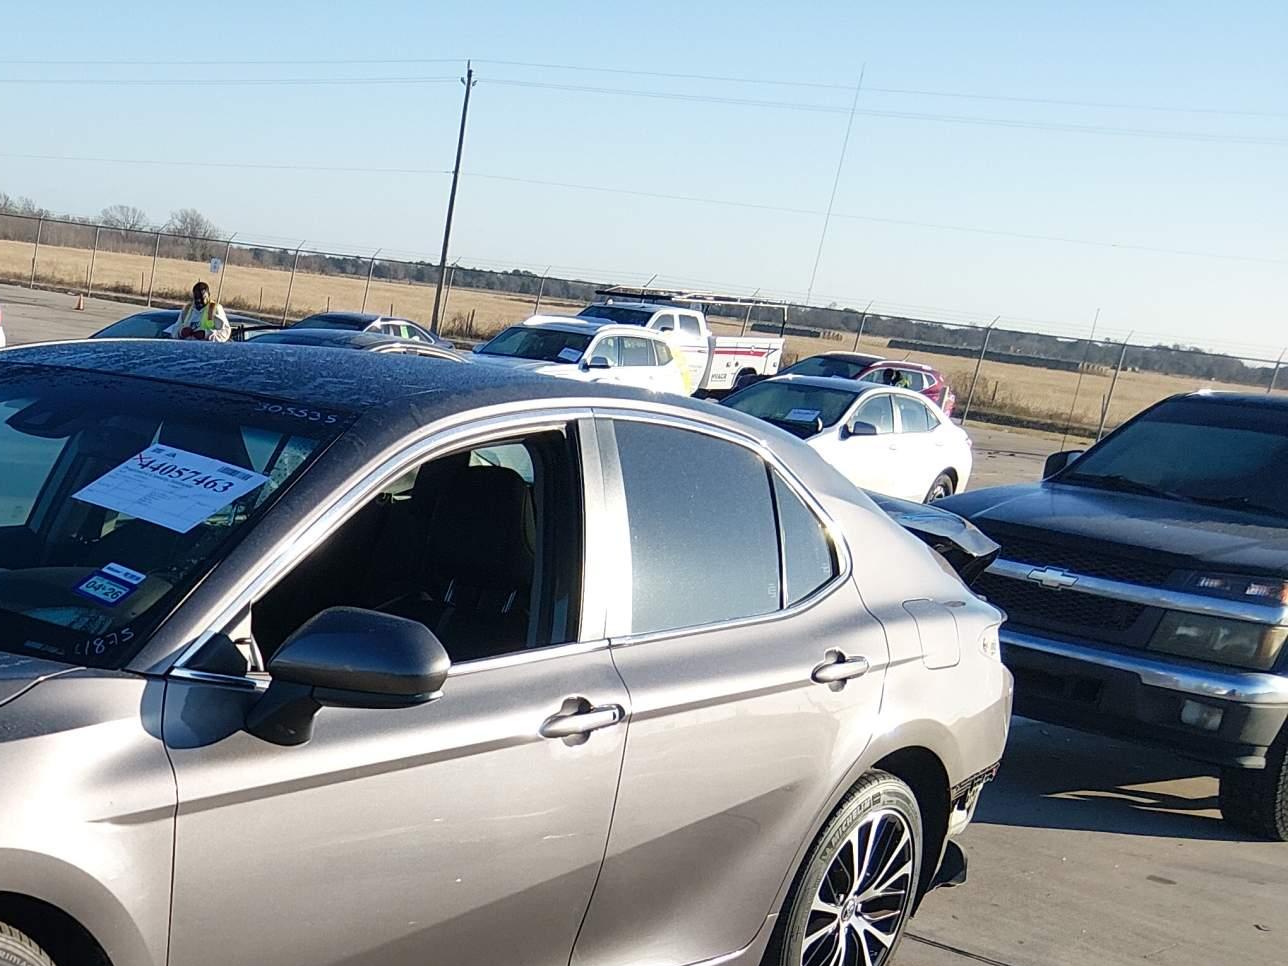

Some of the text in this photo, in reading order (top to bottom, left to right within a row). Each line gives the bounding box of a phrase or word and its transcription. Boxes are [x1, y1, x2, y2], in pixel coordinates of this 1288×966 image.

[136, 459, 234, 493] 44057463
[103, 587, 123, 600] 26
[831, 797, 871, 847] MICHELIN
